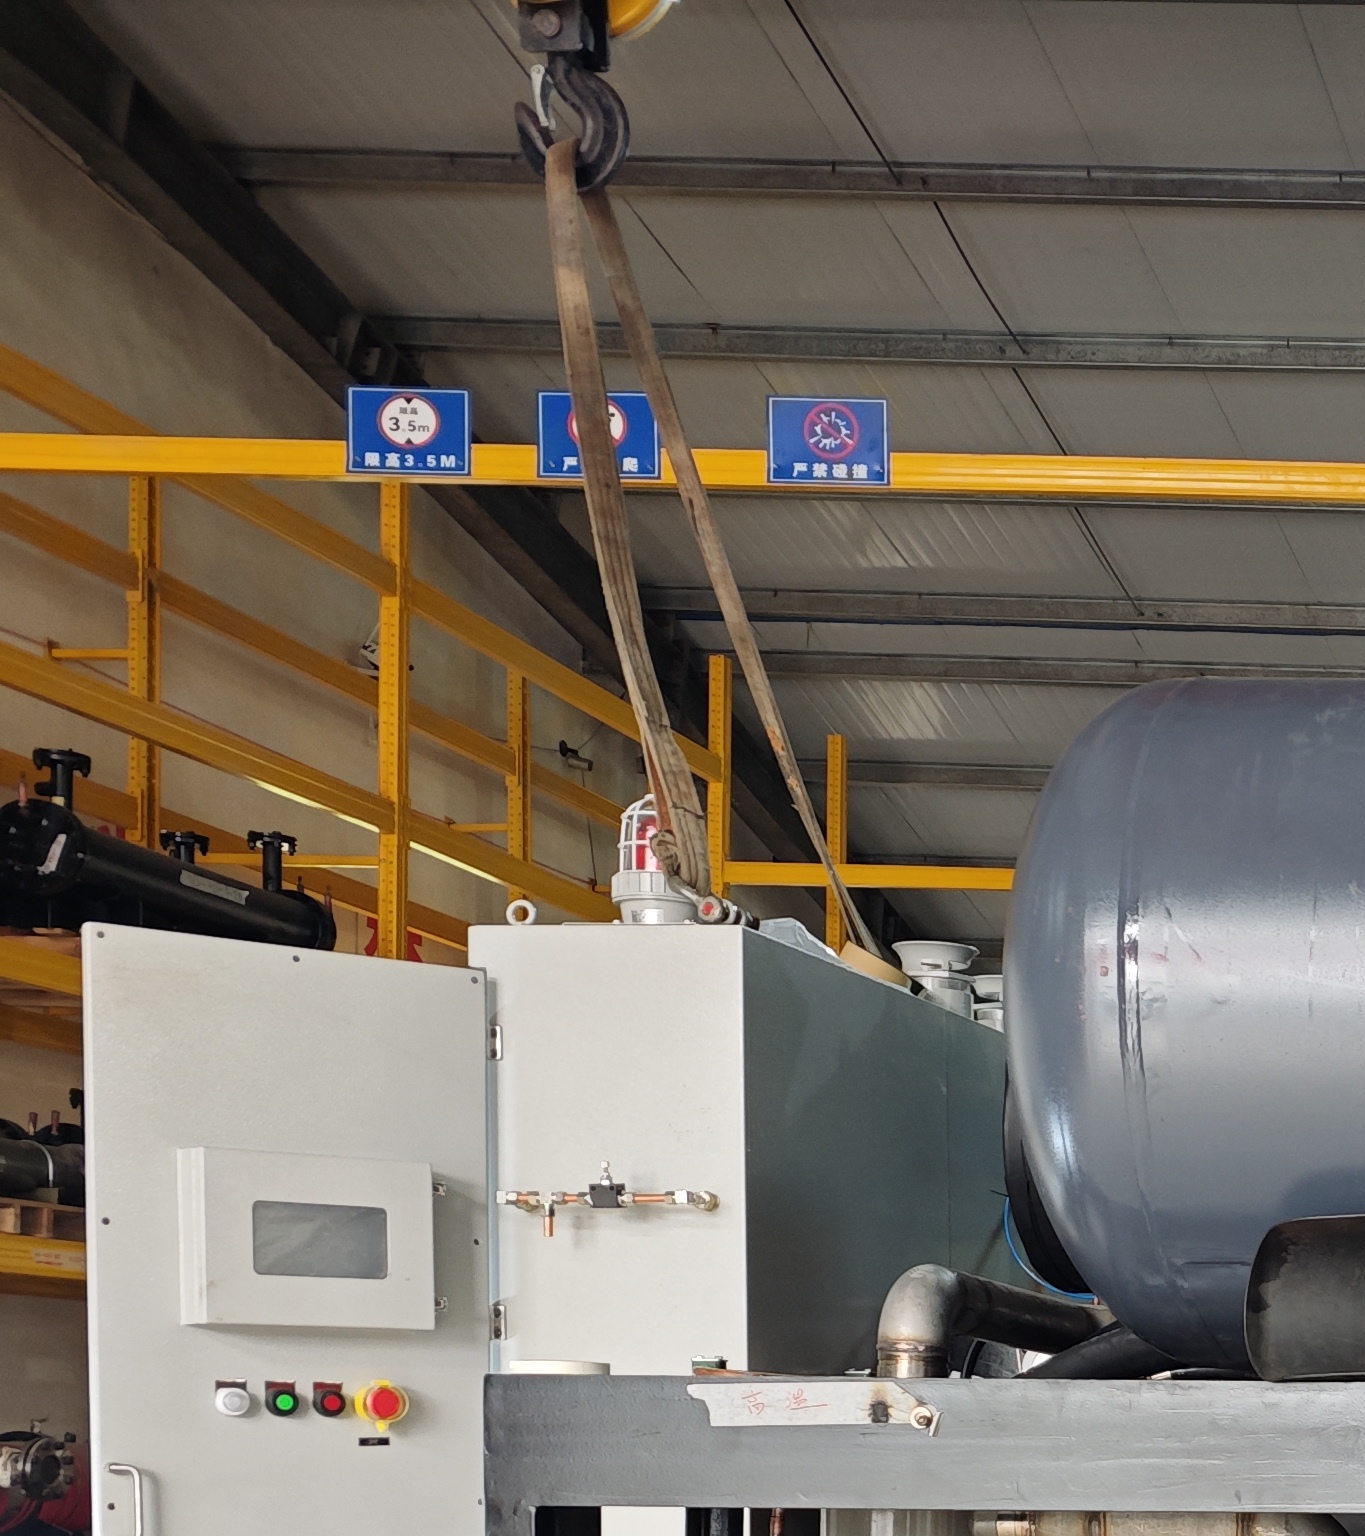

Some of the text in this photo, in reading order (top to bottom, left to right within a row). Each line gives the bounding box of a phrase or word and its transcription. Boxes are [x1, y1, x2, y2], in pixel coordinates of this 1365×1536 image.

[388, 417, 430, 432] 3.5m
[364, 452, 456, 468] 限高3.5M
[792, 462, 868, 478] 严禁碰撞
